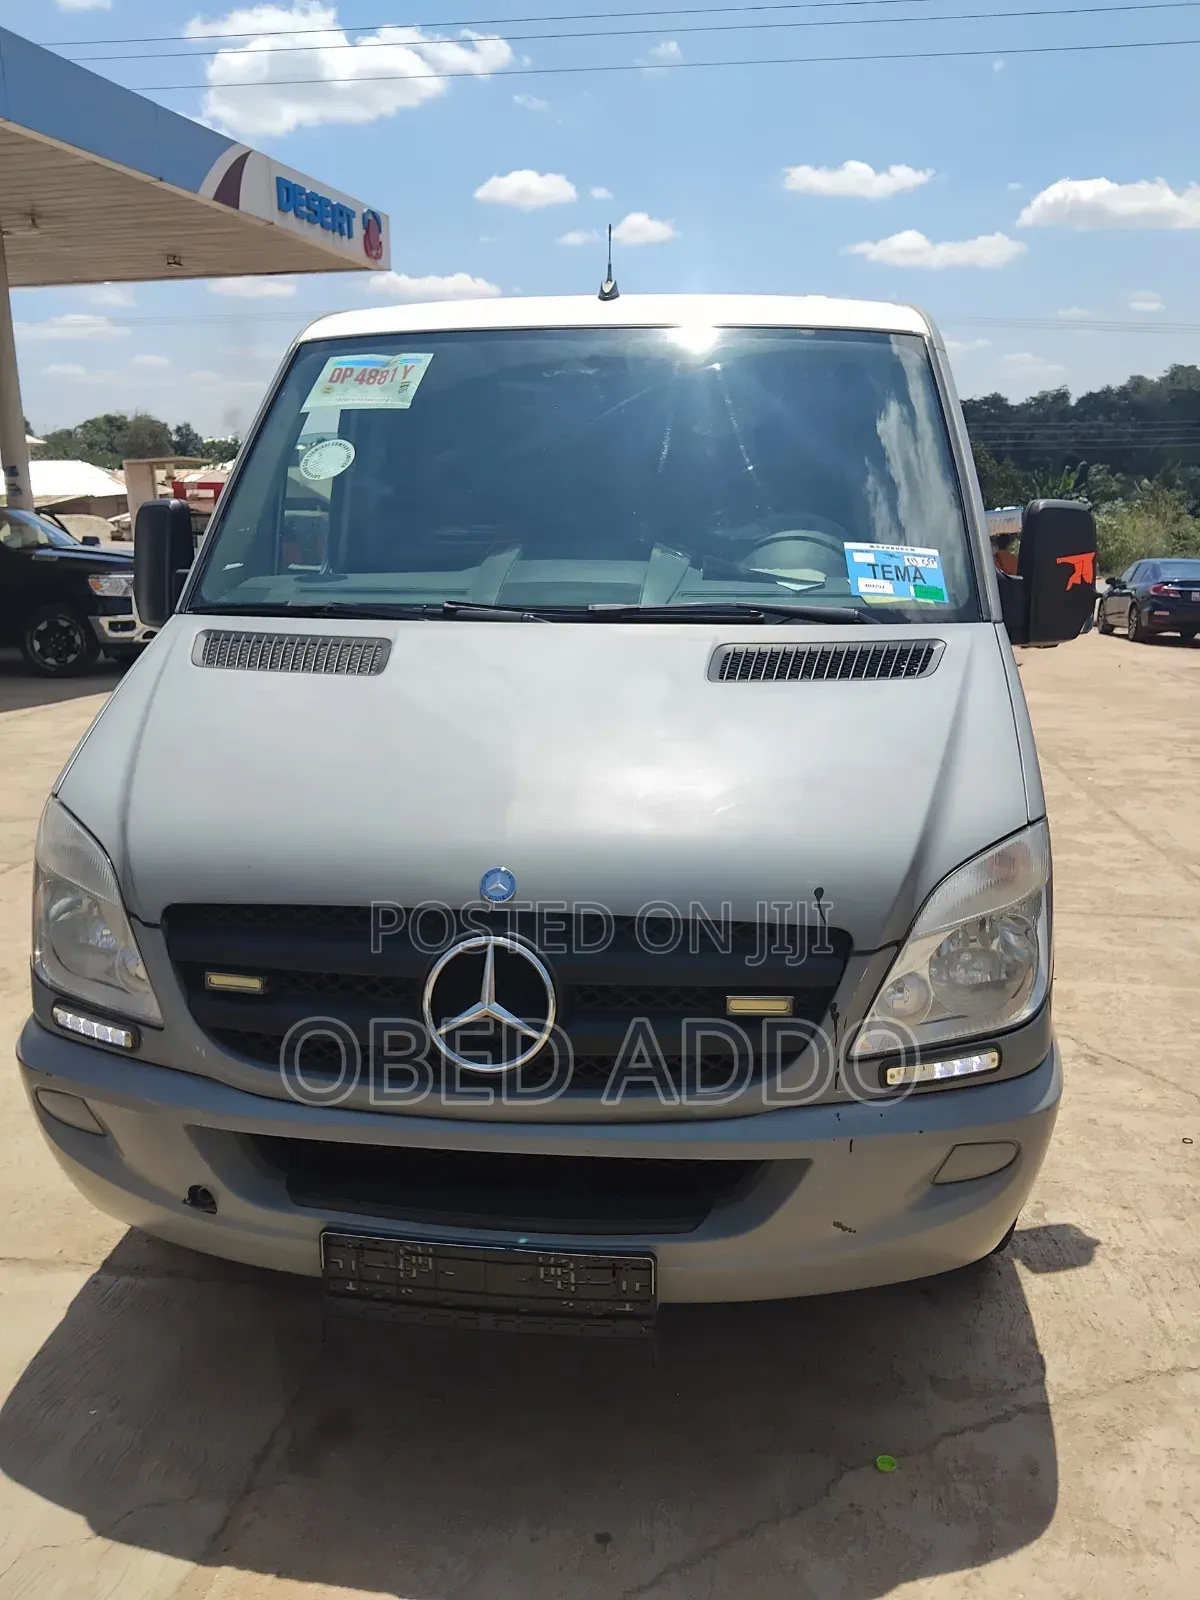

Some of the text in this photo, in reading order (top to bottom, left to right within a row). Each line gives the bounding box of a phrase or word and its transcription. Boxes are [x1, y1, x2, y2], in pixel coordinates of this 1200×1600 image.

[276, 176, 356, 239] DESERT
[328, 365, 415, 385] DP 4881 Y
[867, 563, 926, 584] TEMA
